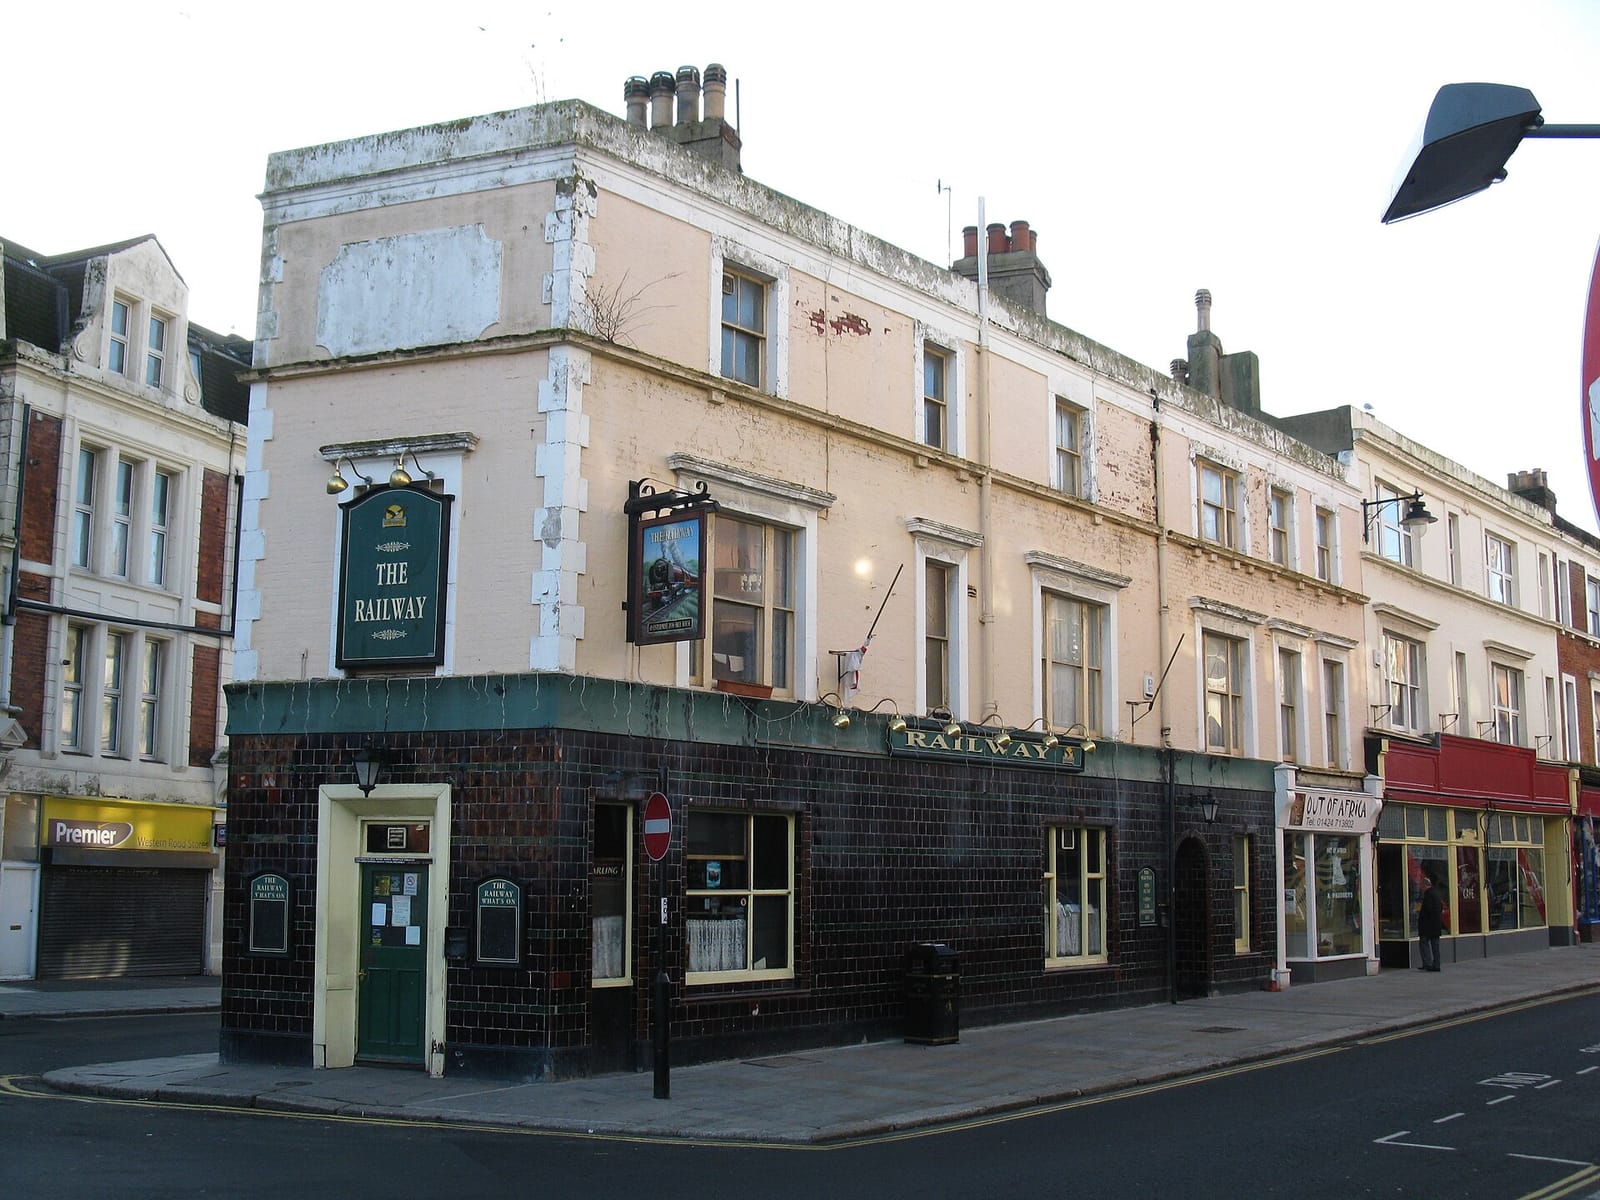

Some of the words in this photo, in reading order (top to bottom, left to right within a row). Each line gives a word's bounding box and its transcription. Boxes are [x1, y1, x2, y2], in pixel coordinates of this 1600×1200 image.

[651, 532, 664, 543] THE
[666, 526, 694, 541] RAILWAY
[375, 562, 408, 586] THE
[354, 596, 427, 622] RAILWAY
[904, 731, 1050, 760] RAILWAY
[1306, 796, 1325, 815] OUT
[1327, 796, 1338, 815] OF
[1316, 817, 1334, 827] 01424
[56, 822, 117, 845] Premier
[137, 836, 167, 848] Western
[484, 890, 513, 898] RAILWAY
